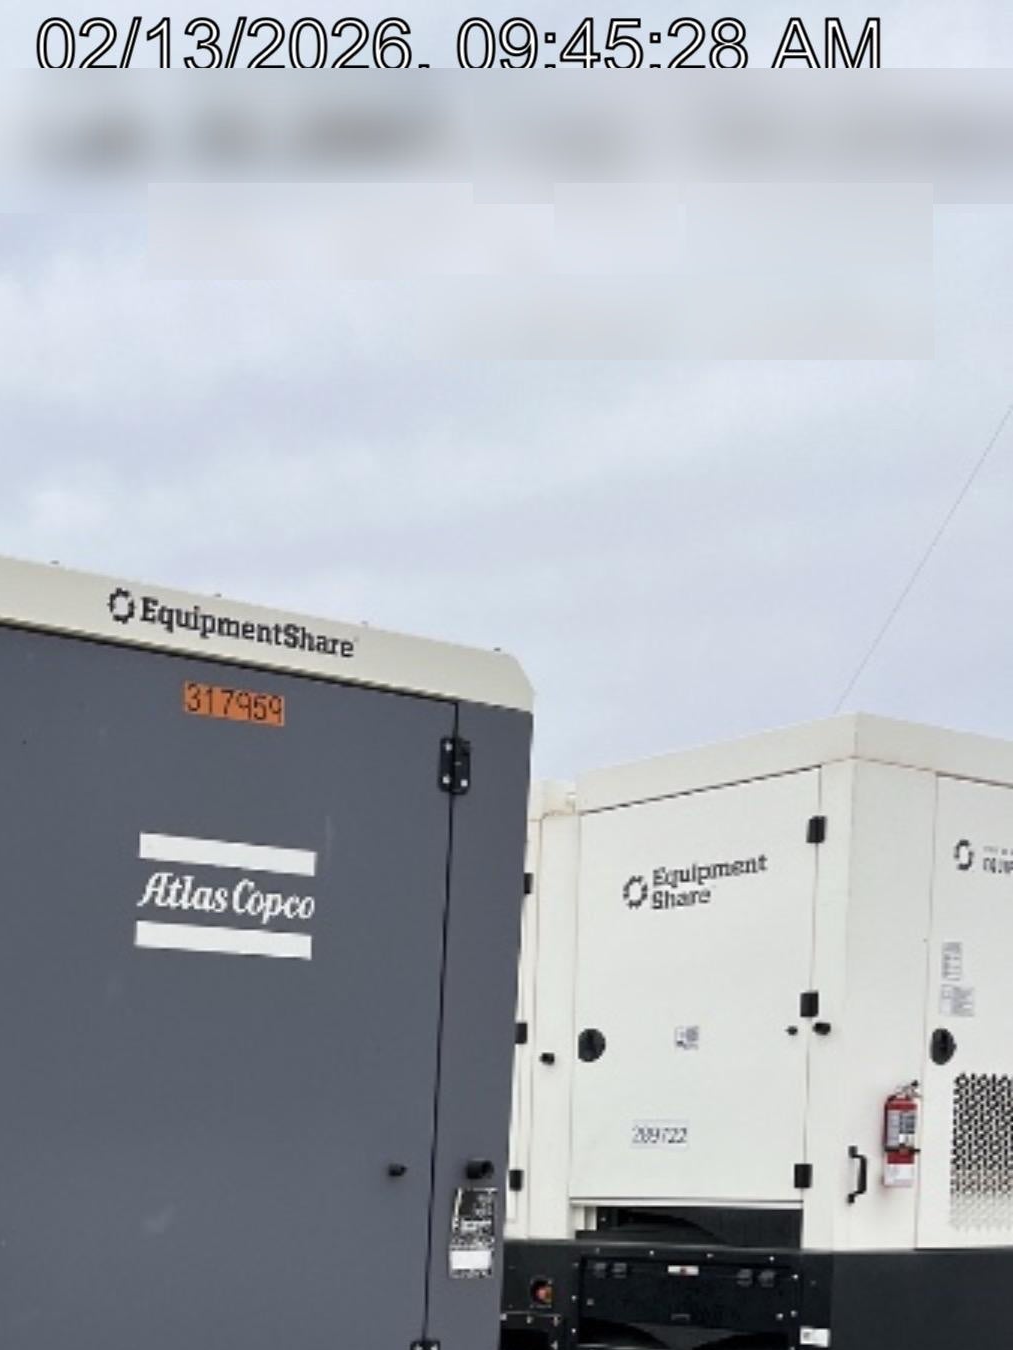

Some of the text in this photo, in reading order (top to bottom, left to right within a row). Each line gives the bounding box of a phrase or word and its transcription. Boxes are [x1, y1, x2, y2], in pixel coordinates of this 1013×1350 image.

[140, 595, 354, 657] EquipmentShare
[187, 683, 283, 724] 317959
[652, 854, 768, 888] Equipment
[137, 871, 316, 924] Atlas Copco
[652, 889, 712, 910] Share
